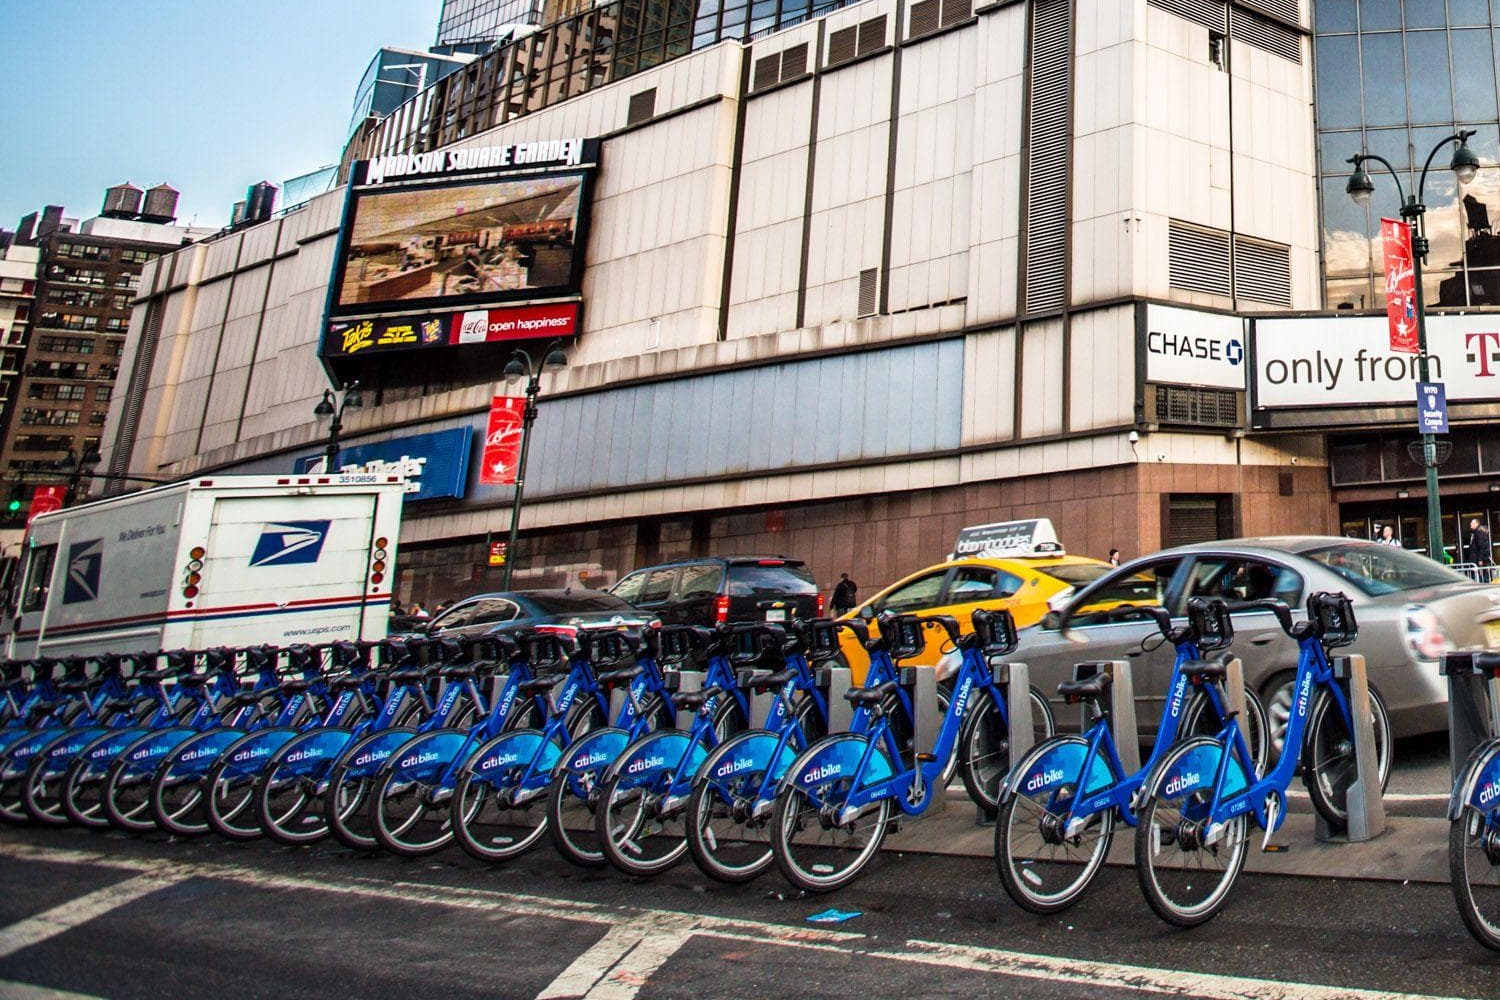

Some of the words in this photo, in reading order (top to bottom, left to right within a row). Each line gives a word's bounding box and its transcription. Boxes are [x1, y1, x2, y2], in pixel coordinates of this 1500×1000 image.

[365, 151, 446, 184] MADISON
[447, 144, 512, 170] SQUARE
[514, 138, 584, 166] GARDEN
[489, 321, 515, 333] open
[517, 317, 568, 330] happiness
[1147, 331, 1222, 361] CHASE
[1265, 350, 1344, 390] only
[1354, 349, 1442, 382] from
[1423, 386, 1438, 395] NYPD
[1424, 409, 1443, 419] Security
[1424, 417, 1443, 426] Camera
[283, 625, 351, 637] www.usps.com
